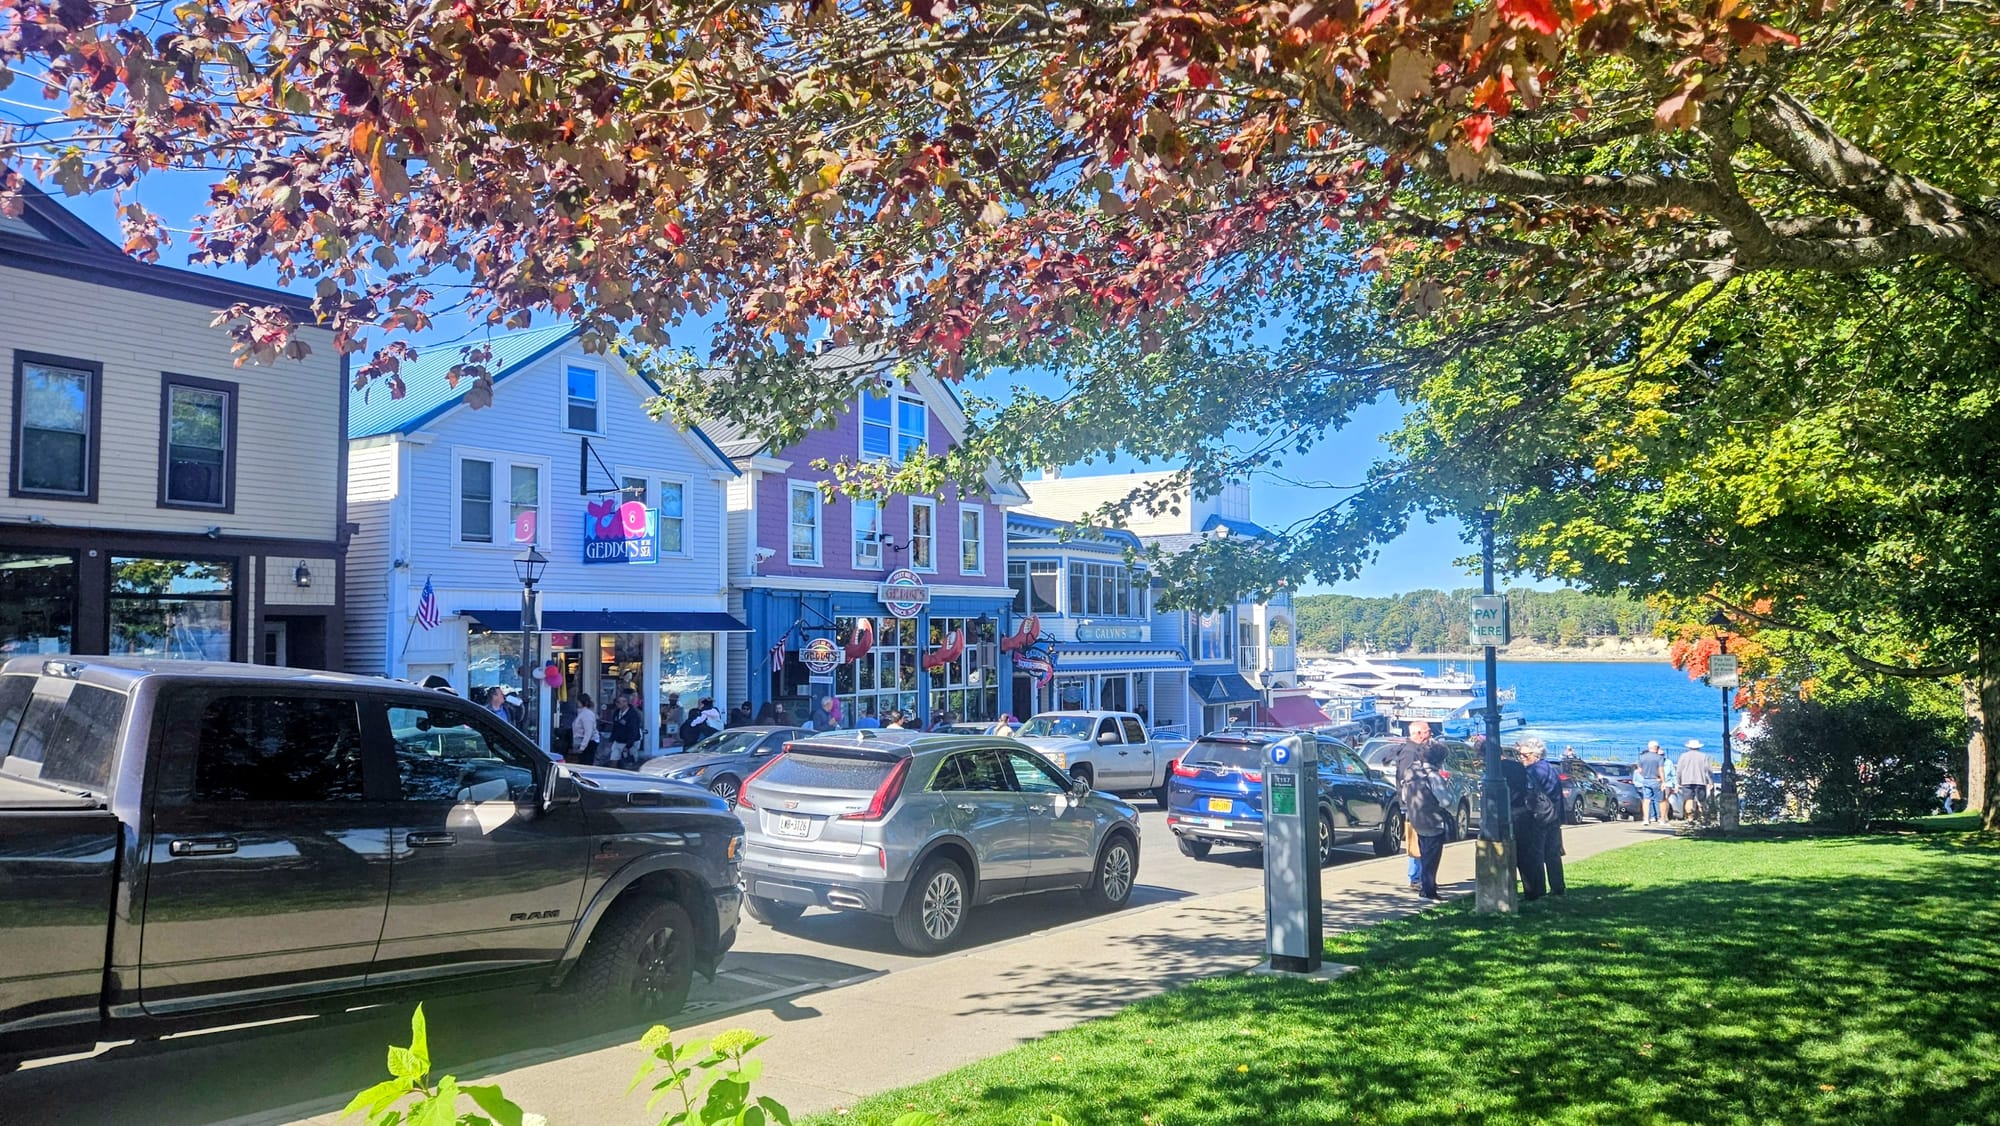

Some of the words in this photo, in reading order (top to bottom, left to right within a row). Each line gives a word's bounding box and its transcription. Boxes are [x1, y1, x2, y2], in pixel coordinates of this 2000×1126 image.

[586, 541, 639, 558] GEDDY'S
[1475, 608, 1498, 619] PAY
[1095, 627, 1127, 640] GALYN'S
[1473, 625, 1502, 636] HERE
[1275, 748, 1286, 762] P
[510, 909, 560, 921] RAM
